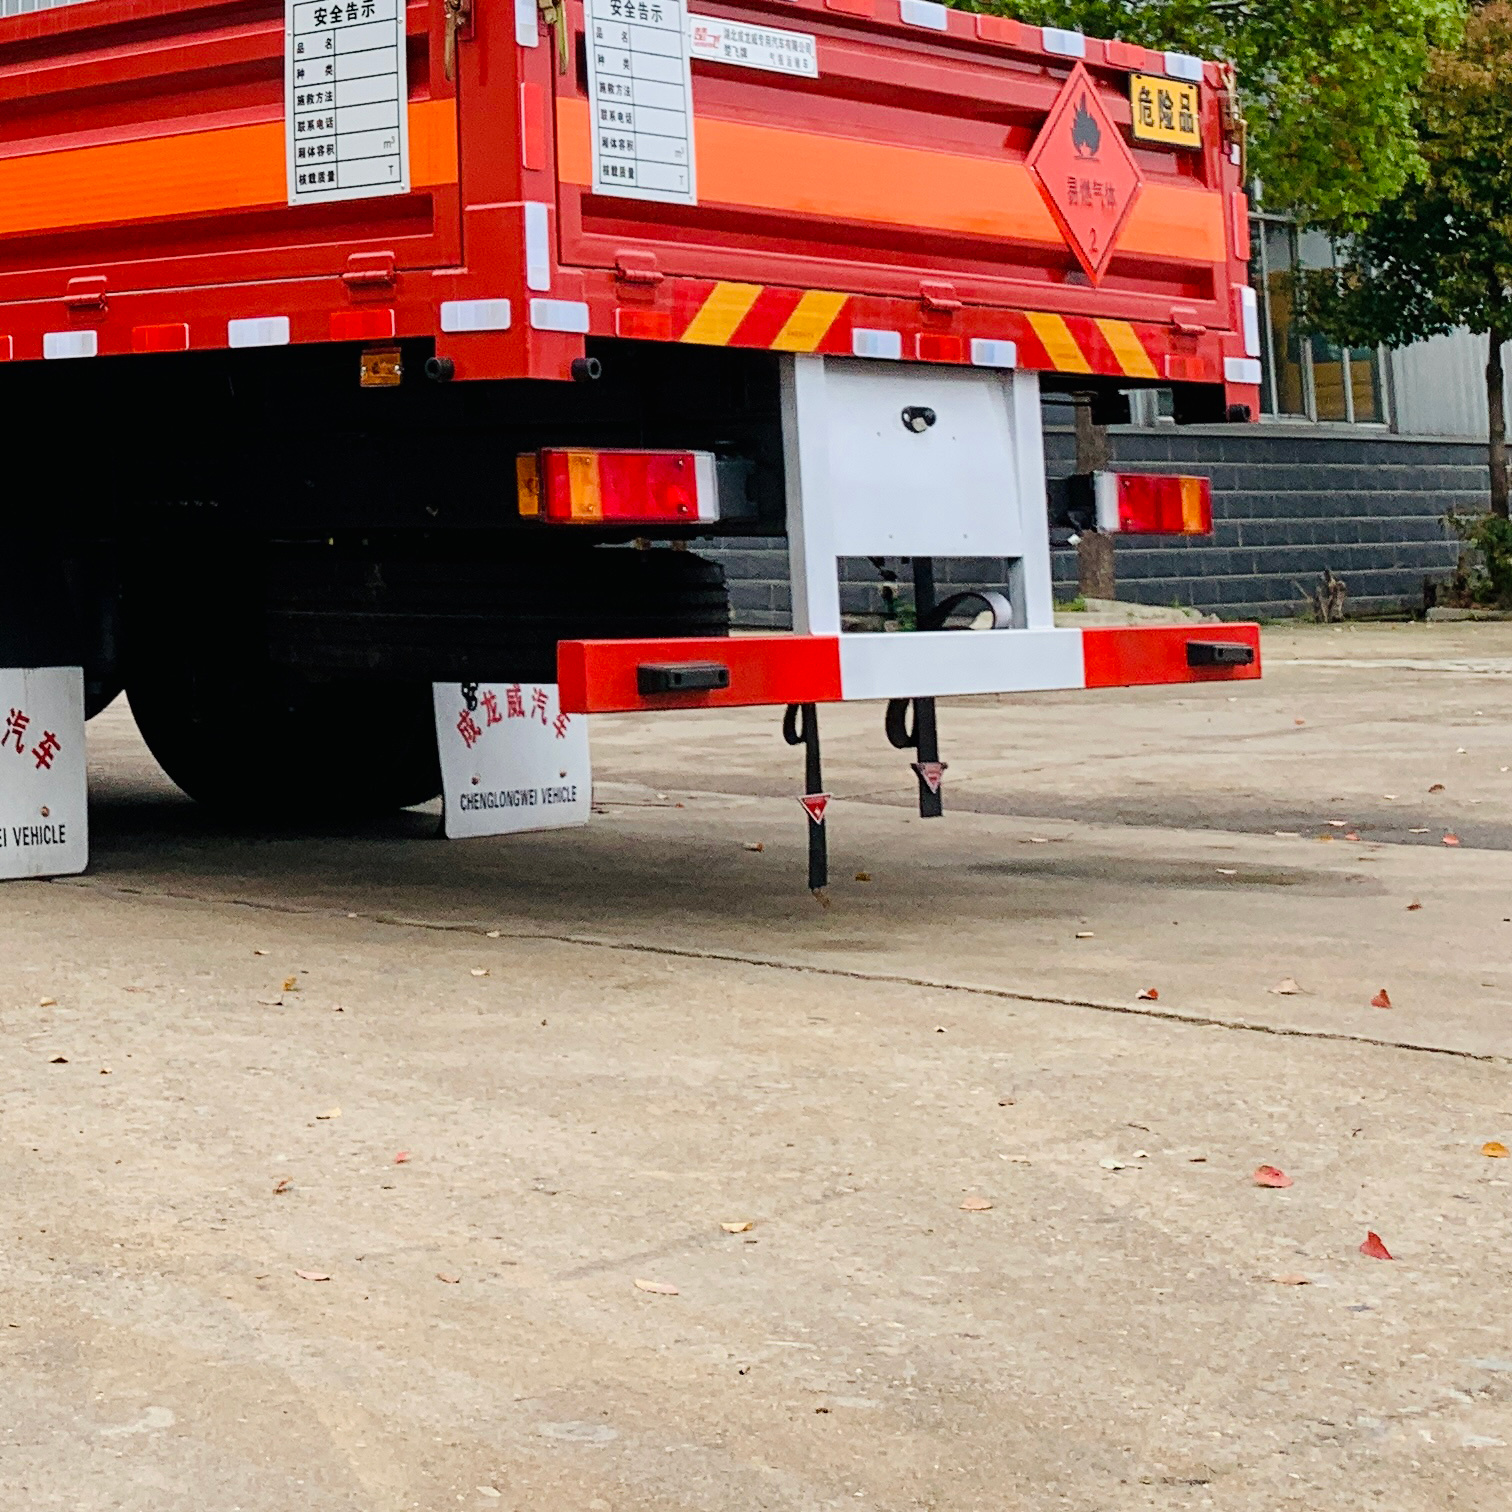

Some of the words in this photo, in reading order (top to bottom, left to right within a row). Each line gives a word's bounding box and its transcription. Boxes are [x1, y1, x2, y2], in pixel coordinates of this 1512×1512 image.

[314, 0, 376, 27] 安全告示
[296, 90, 334, 106] 施救方法
[1138, 85, 1195, 134] 危险品
[297, 117, 334, 133] 联系电话
[600, 109, 633, 125] 联系电话
[298, 169, 336, 186] 核载质量
[1067, 175, 1118, 210] 易燃气体
[1088, 227, 1098, 253] 2
[460, 788, 537, 812] CHENGLONGWEI
[541, 785, 577, 806] VEHICLE
[12, 824, 66, 847] VEHICLE
